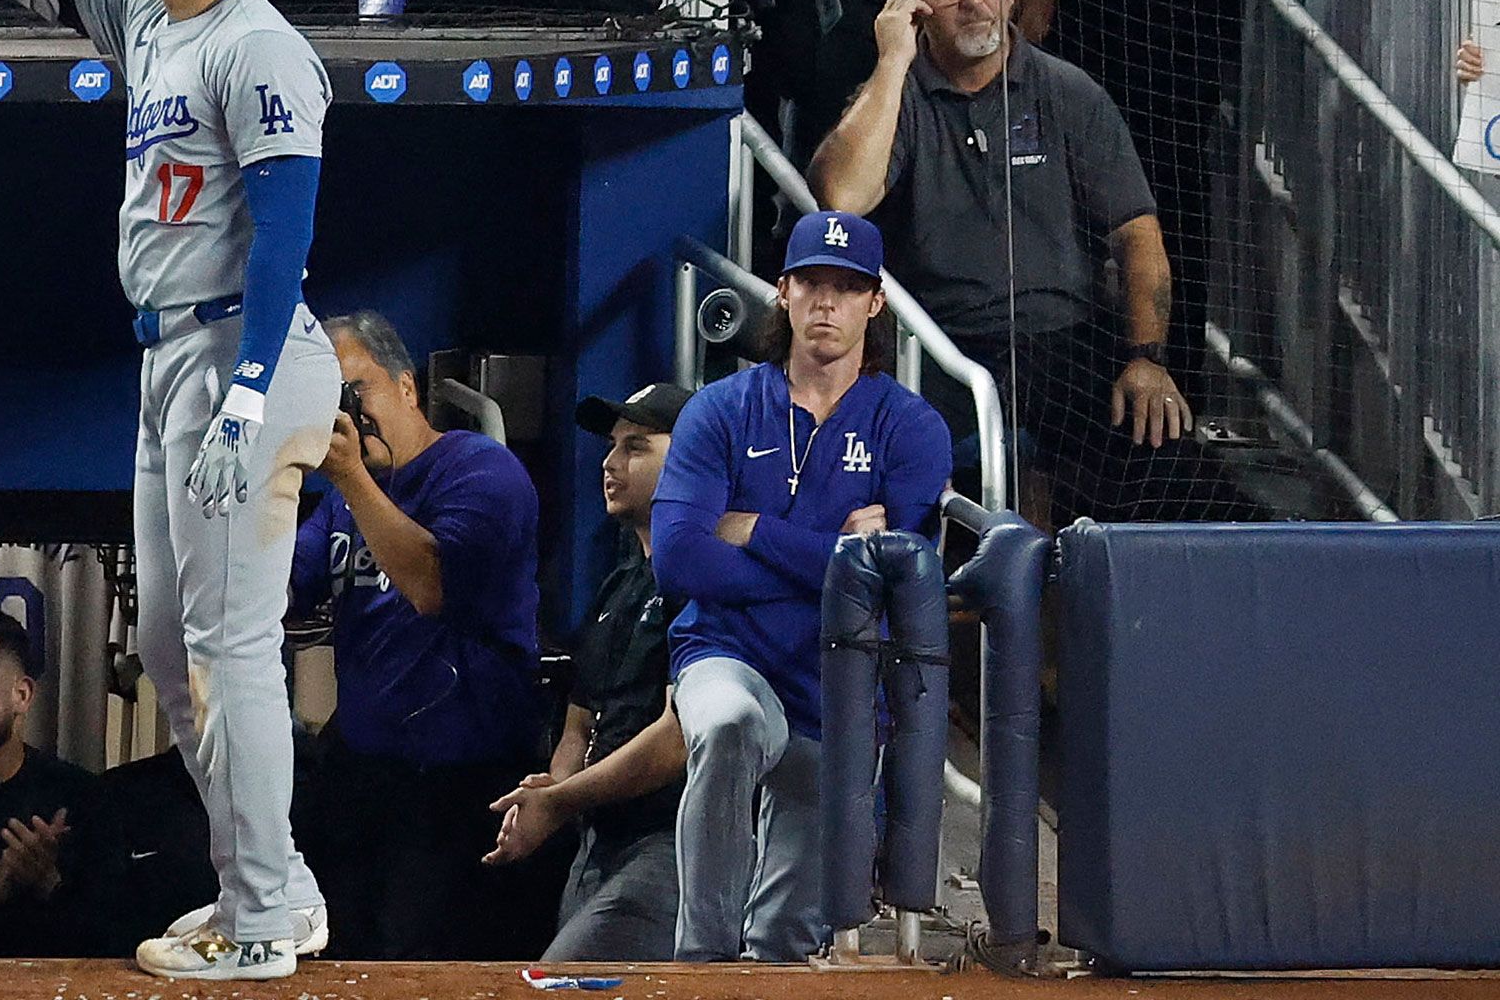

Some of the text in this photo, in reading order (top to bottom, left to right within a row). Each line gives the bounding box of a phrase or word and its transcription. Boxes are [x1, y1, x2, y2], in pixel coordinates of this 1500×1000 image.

[635, 63, 649, 79] ADT
[674, 60, 688, 77] ADT
[713, 56, 728, 73] ADT
[74, 72, 106, 88] ADT
[370, 74, 401, 90] ADT
[468, 74, 490, 90] ADT
[516, 72, 530, 88] ADT
[556, 69, 570, 86] ADT
[596, 66, 610, 82] ADT
[255, 83, 295, 136] LA
[157, 162, 205, 223] 17
[824, 216, 849, 248] LA
[842, 431, 872, 473] LA
